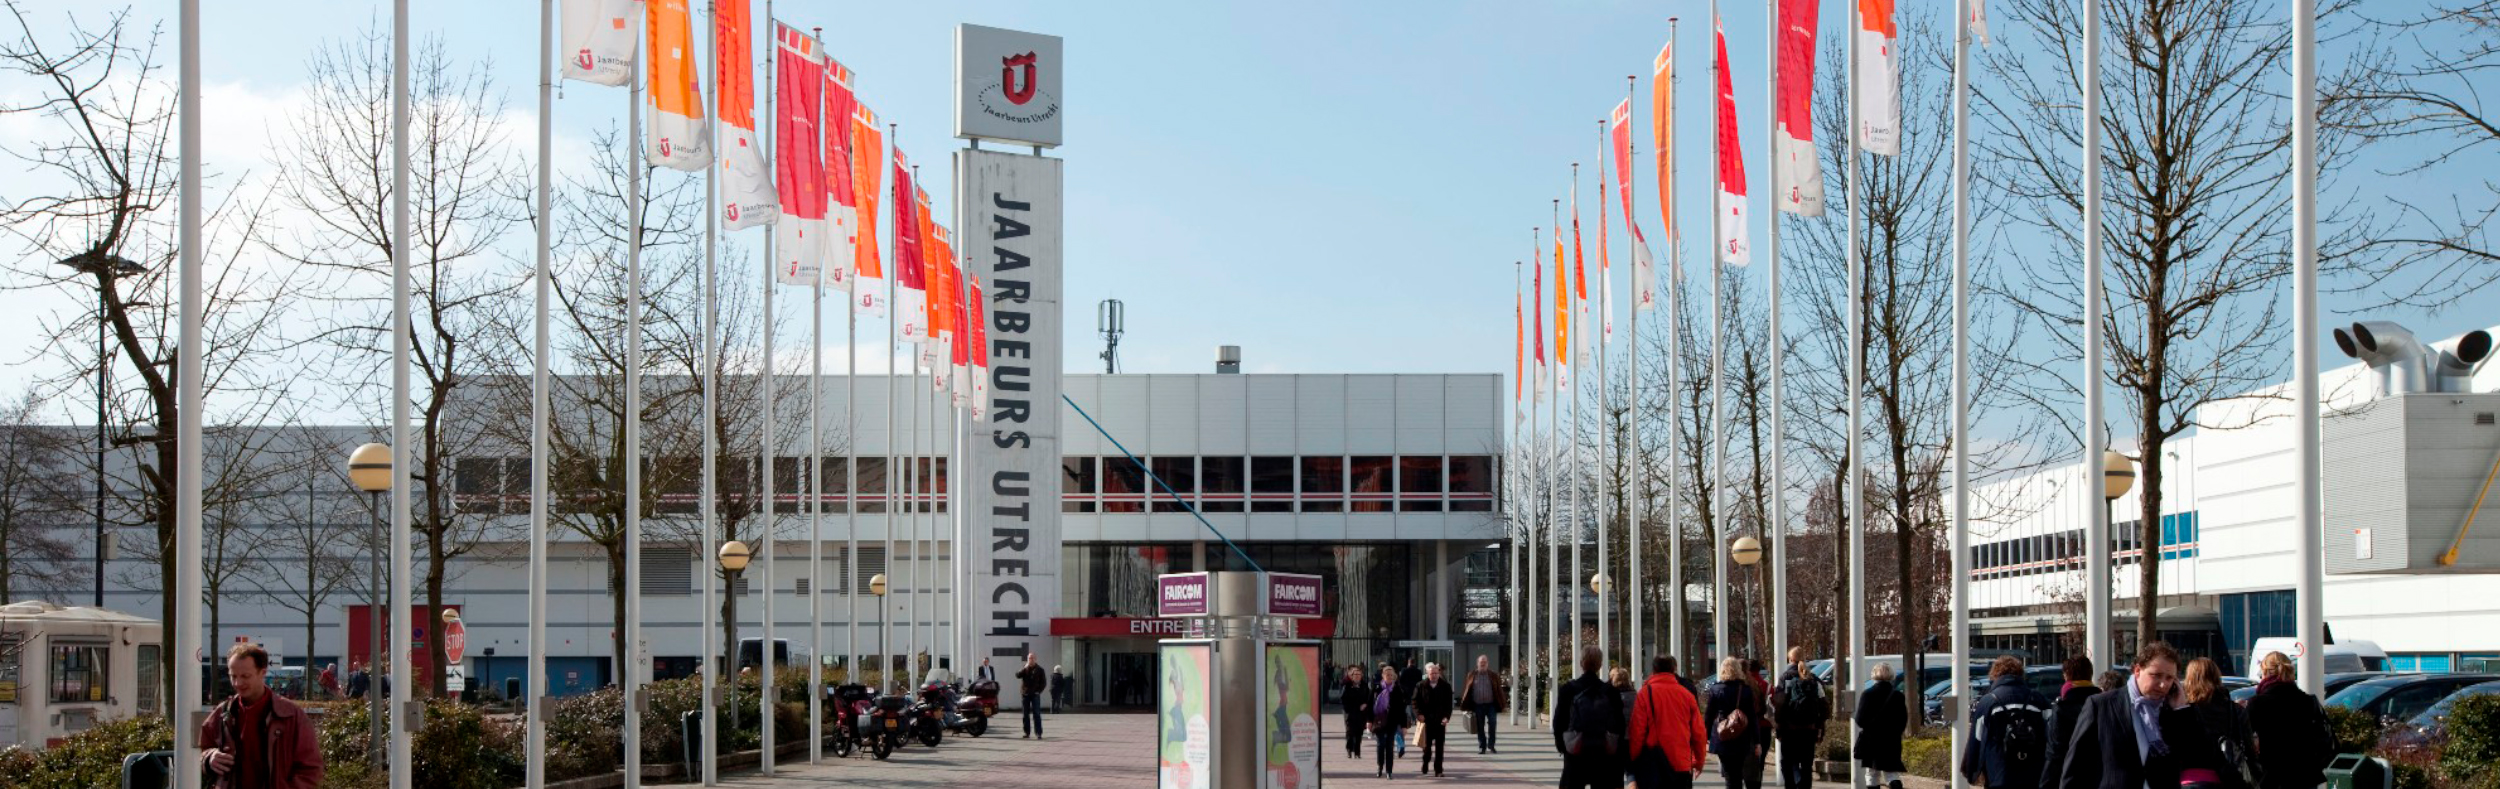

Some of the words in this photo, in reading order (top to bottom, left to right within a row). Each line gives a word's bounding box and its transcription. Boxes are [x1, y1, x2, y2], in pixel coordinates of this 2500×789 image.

[984, 105, 1031, 123] Jaarbeurs
[1031, 103, 1059, 123] Utrecht
[993, 192, 1031, 448] JAARBEURS
[992, 471, 1030, 662] UTRECHT
[1165, 584, 1203, 600] FAIRCOM
[1275, 584, 1316, 601] FAIRCOM
[446, 633, 464, 650] STOP
